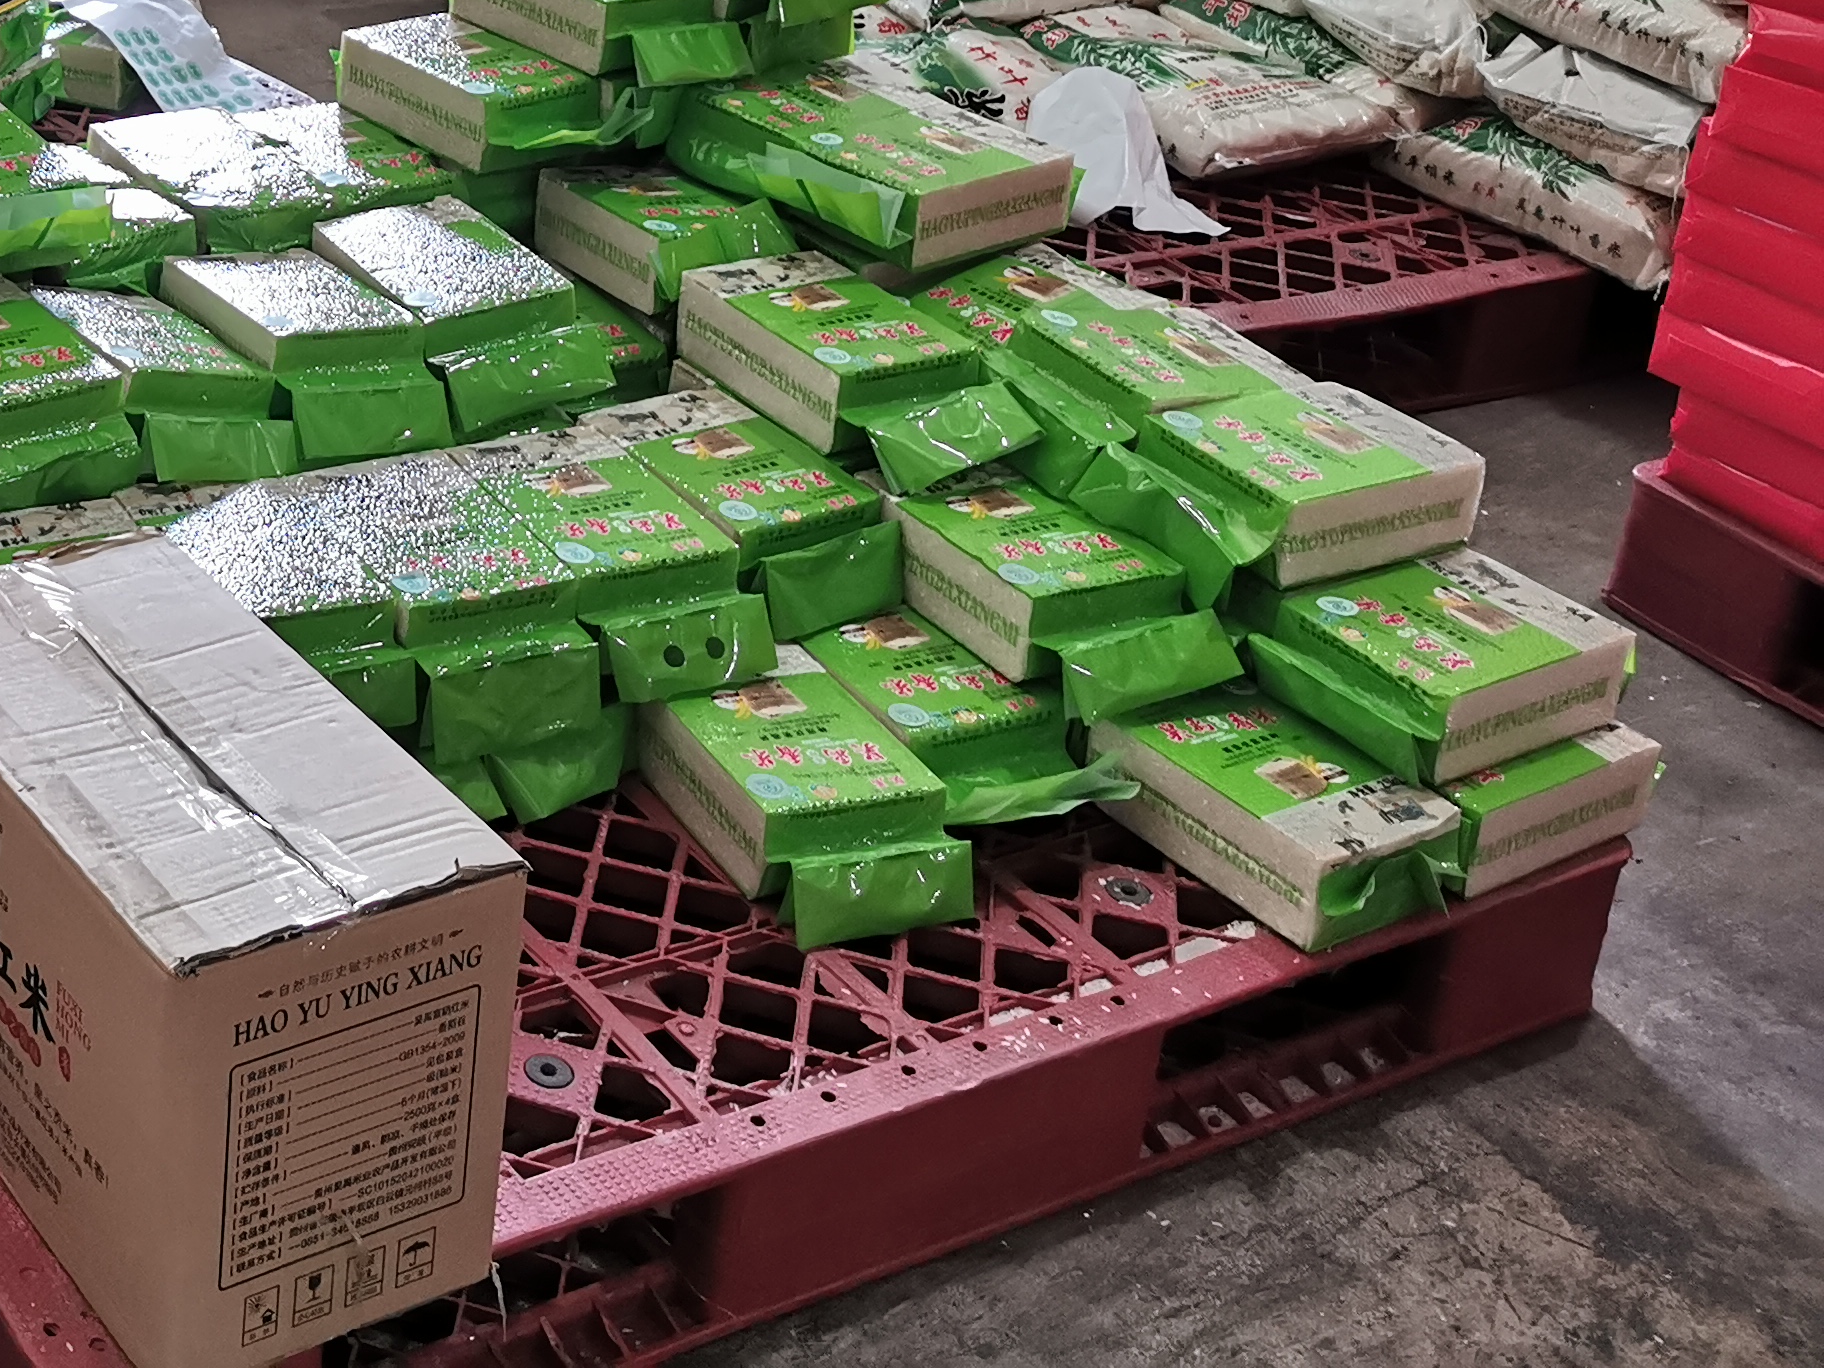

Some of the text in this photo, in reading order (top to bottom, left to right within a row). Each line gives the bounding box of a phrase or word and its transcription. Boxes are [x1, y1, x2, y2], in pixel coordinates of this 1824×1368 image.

[233, 944, 483, 1047] HAO YU YING XIANG
